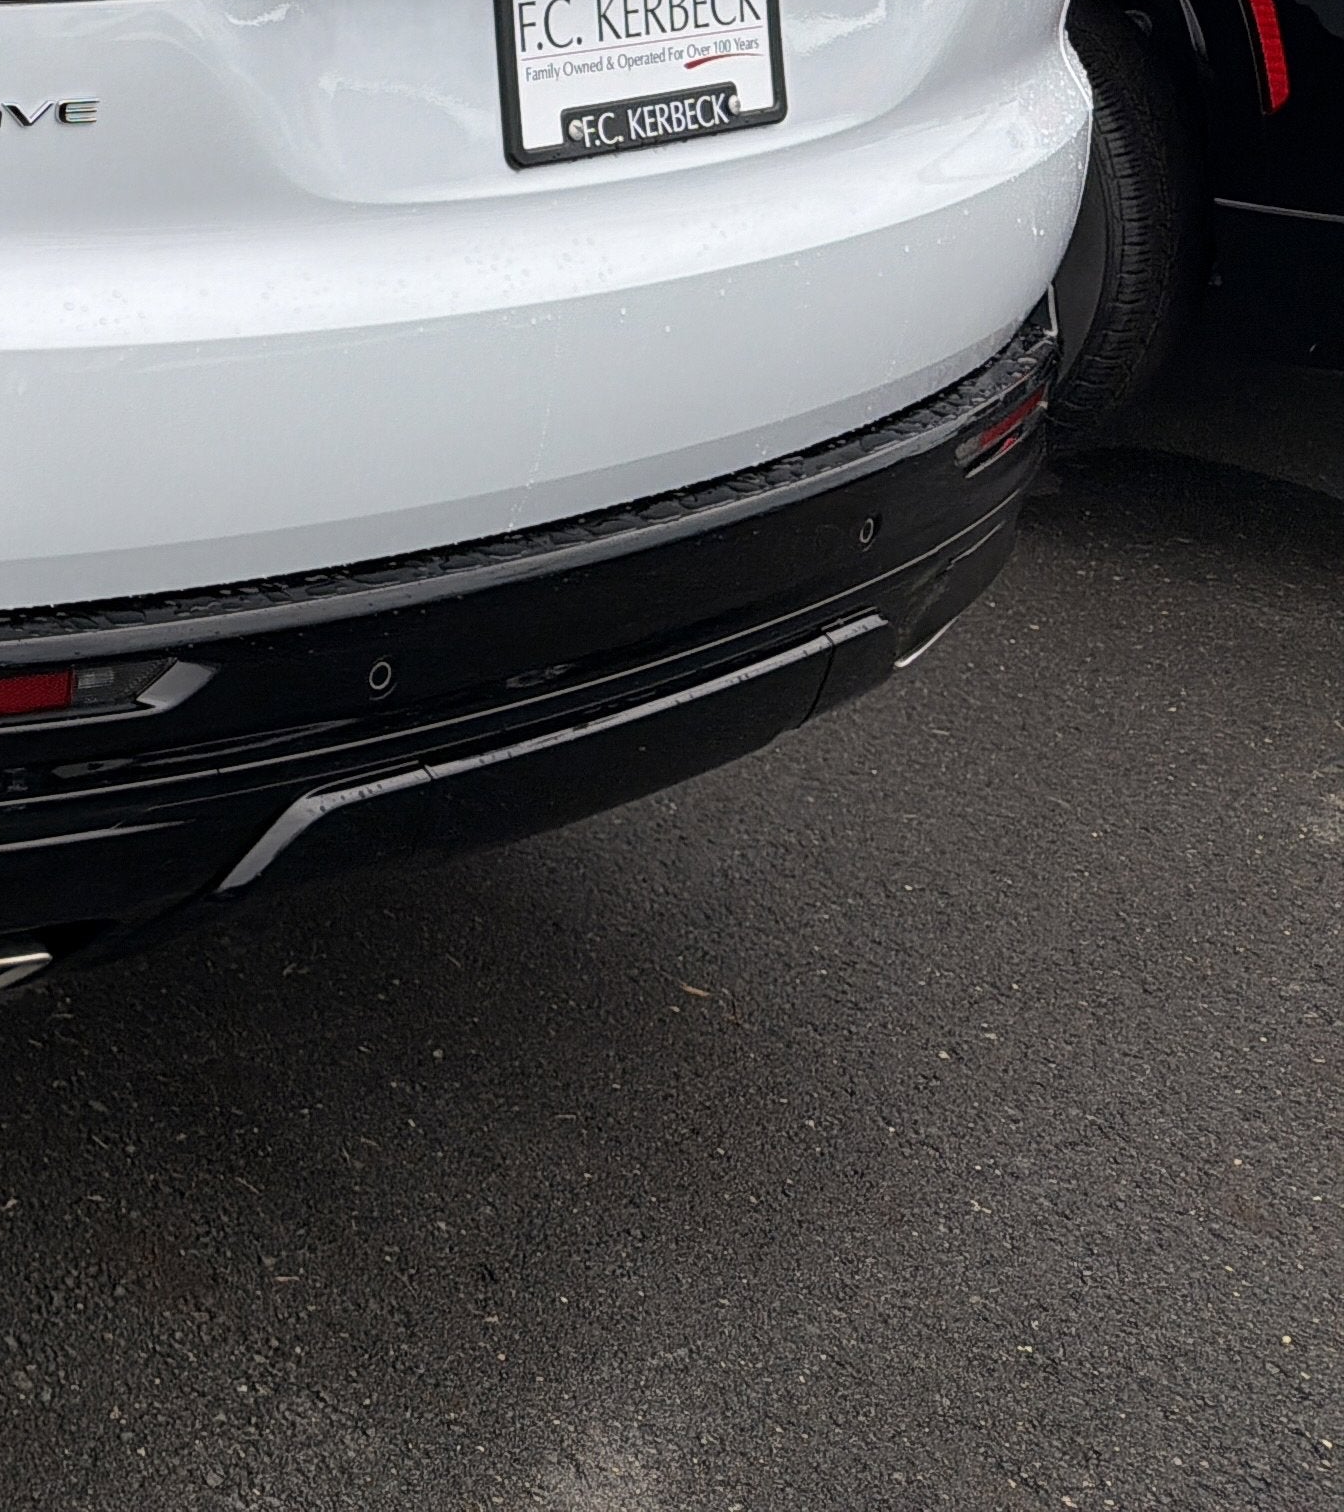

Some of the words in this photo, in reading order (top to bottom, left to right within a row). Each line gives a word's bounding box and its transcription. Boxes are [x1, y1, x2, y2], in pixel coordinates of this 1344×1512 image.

[525, 64, 561, 82] Family
[562, 58, 603, 77] Owned
[606, 56, 614, 70] &
[617, 51, 666, 71] Operated
[668, 47, 684, 63] For
[686, 43, 711, 59] Over
[713, 39, 732, 54] 100
[734, 36, 760, 51] Years
[581, 111, 624, 148] F.C.
[626, 92, 730, 141] KERBECK
